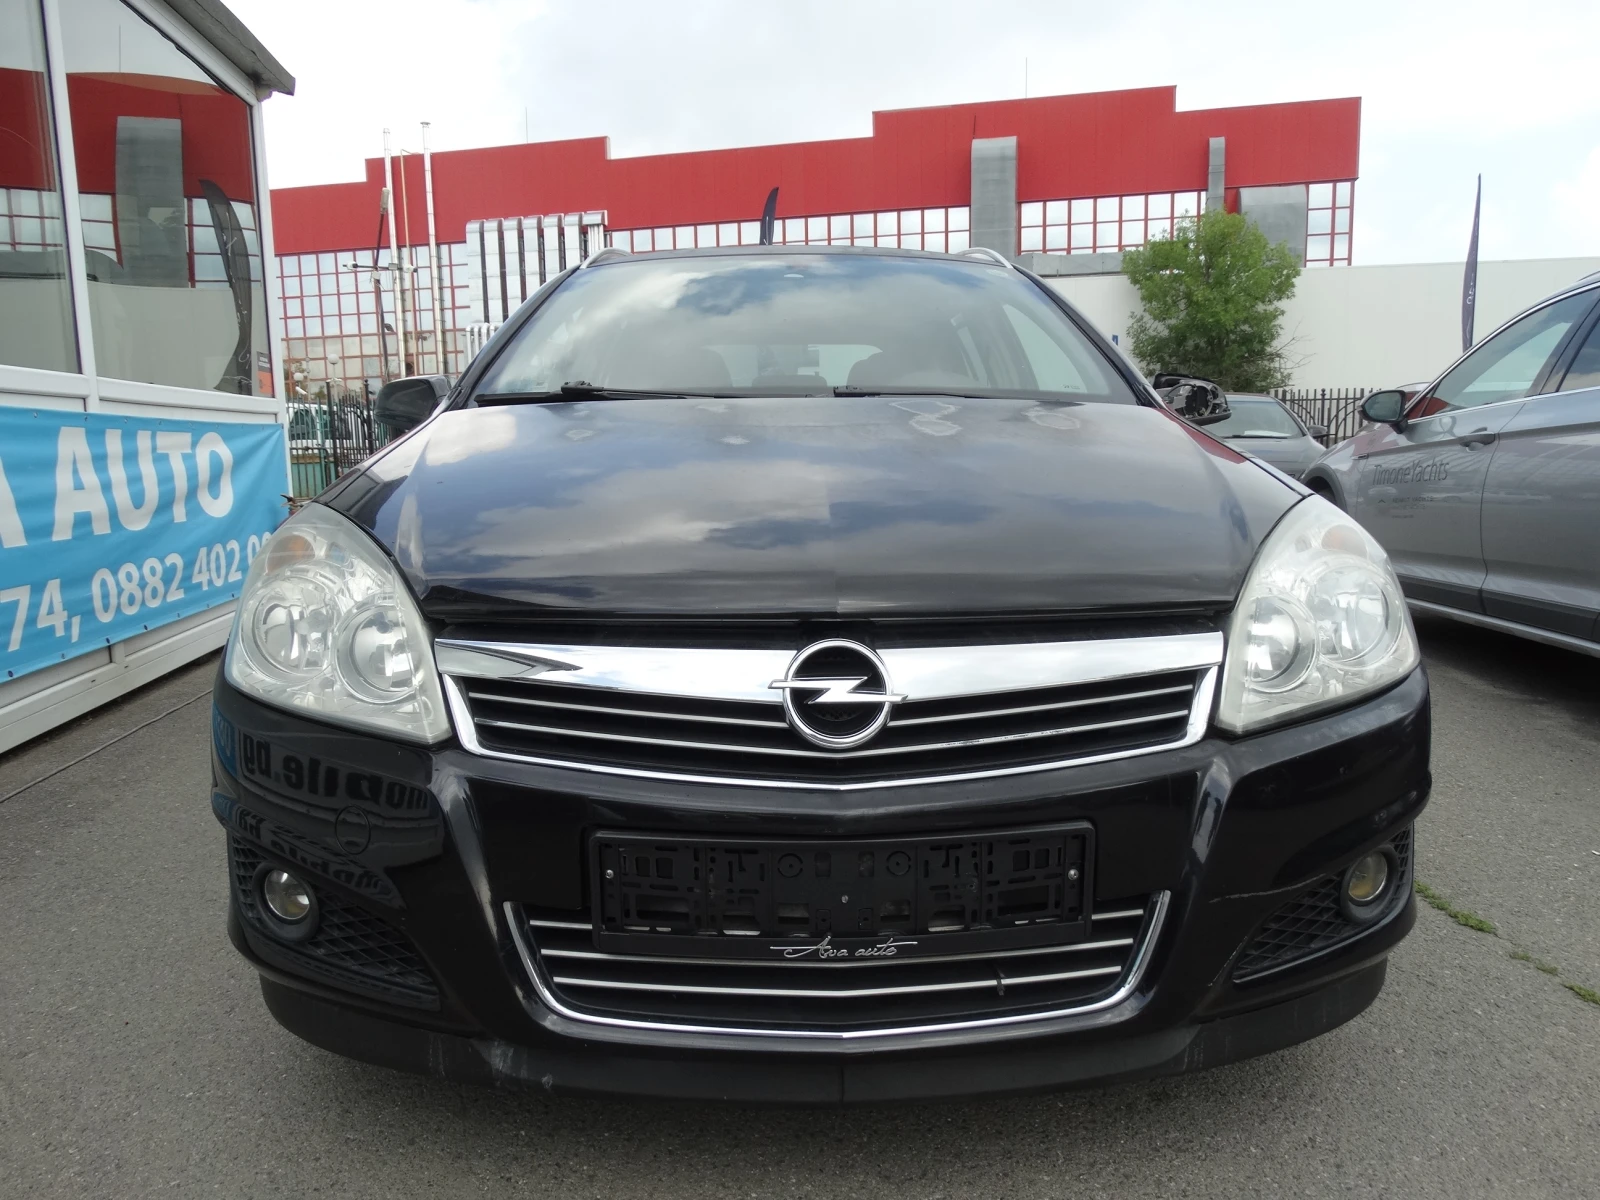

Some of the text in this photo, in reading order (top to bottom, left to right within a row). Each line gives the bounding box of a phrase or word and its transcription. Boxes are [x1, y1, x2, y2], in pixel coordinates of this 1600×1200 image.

[52, 426, 234, 541] AUTO
[92, 563, 185, 623] 0882
[192, 540, 242, 590] 402
[855, 938, 918, 956] auto
